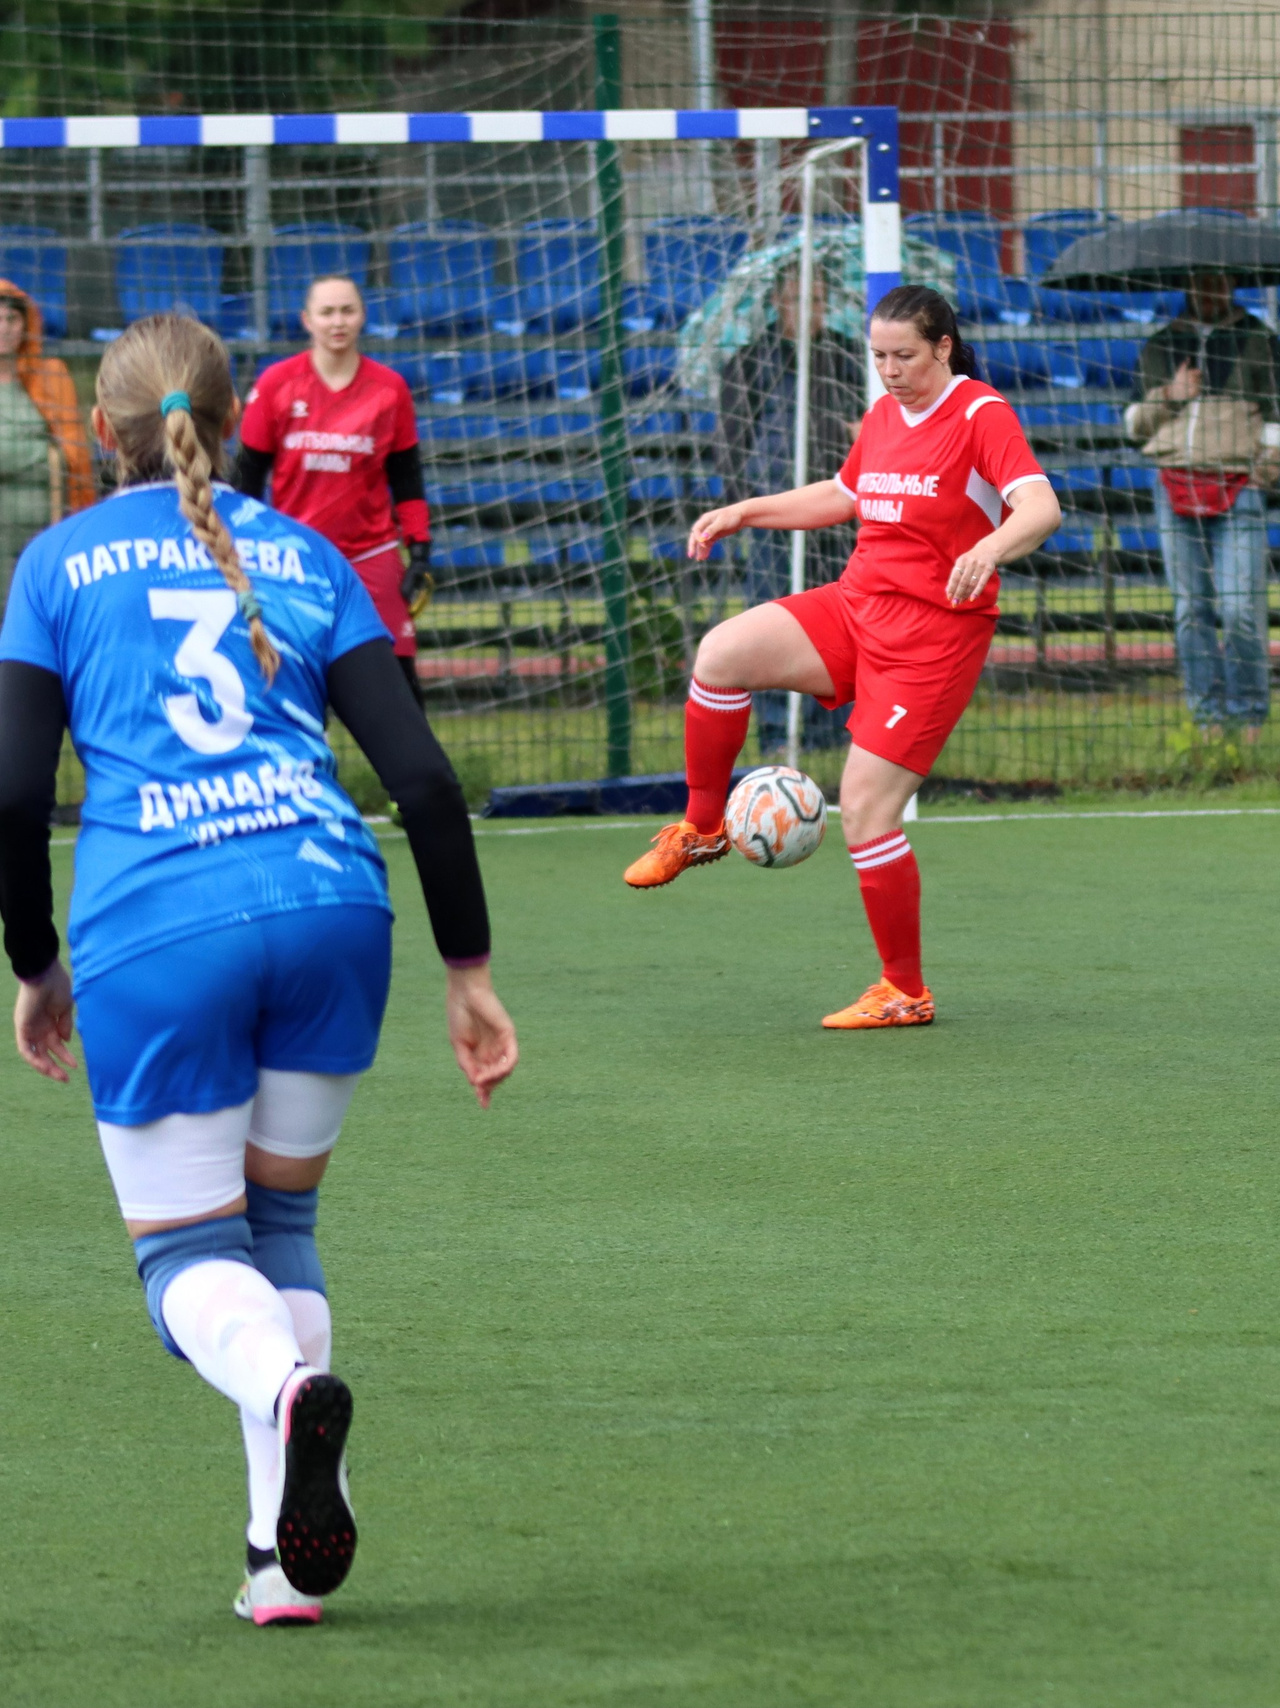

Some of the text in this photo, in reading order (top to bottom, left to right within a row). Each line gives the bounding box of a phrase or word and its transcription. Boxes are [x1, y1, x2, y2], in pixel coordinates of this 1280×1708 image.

[861, 499, 904, 523] МАМЫ
[65, 537, 306, 590] ПАТРАКЕВА
[147, 588, 255, 755] 3
[884, 704, 908, 730] 7
[139, 760, 323, 833] ДИНАМО
